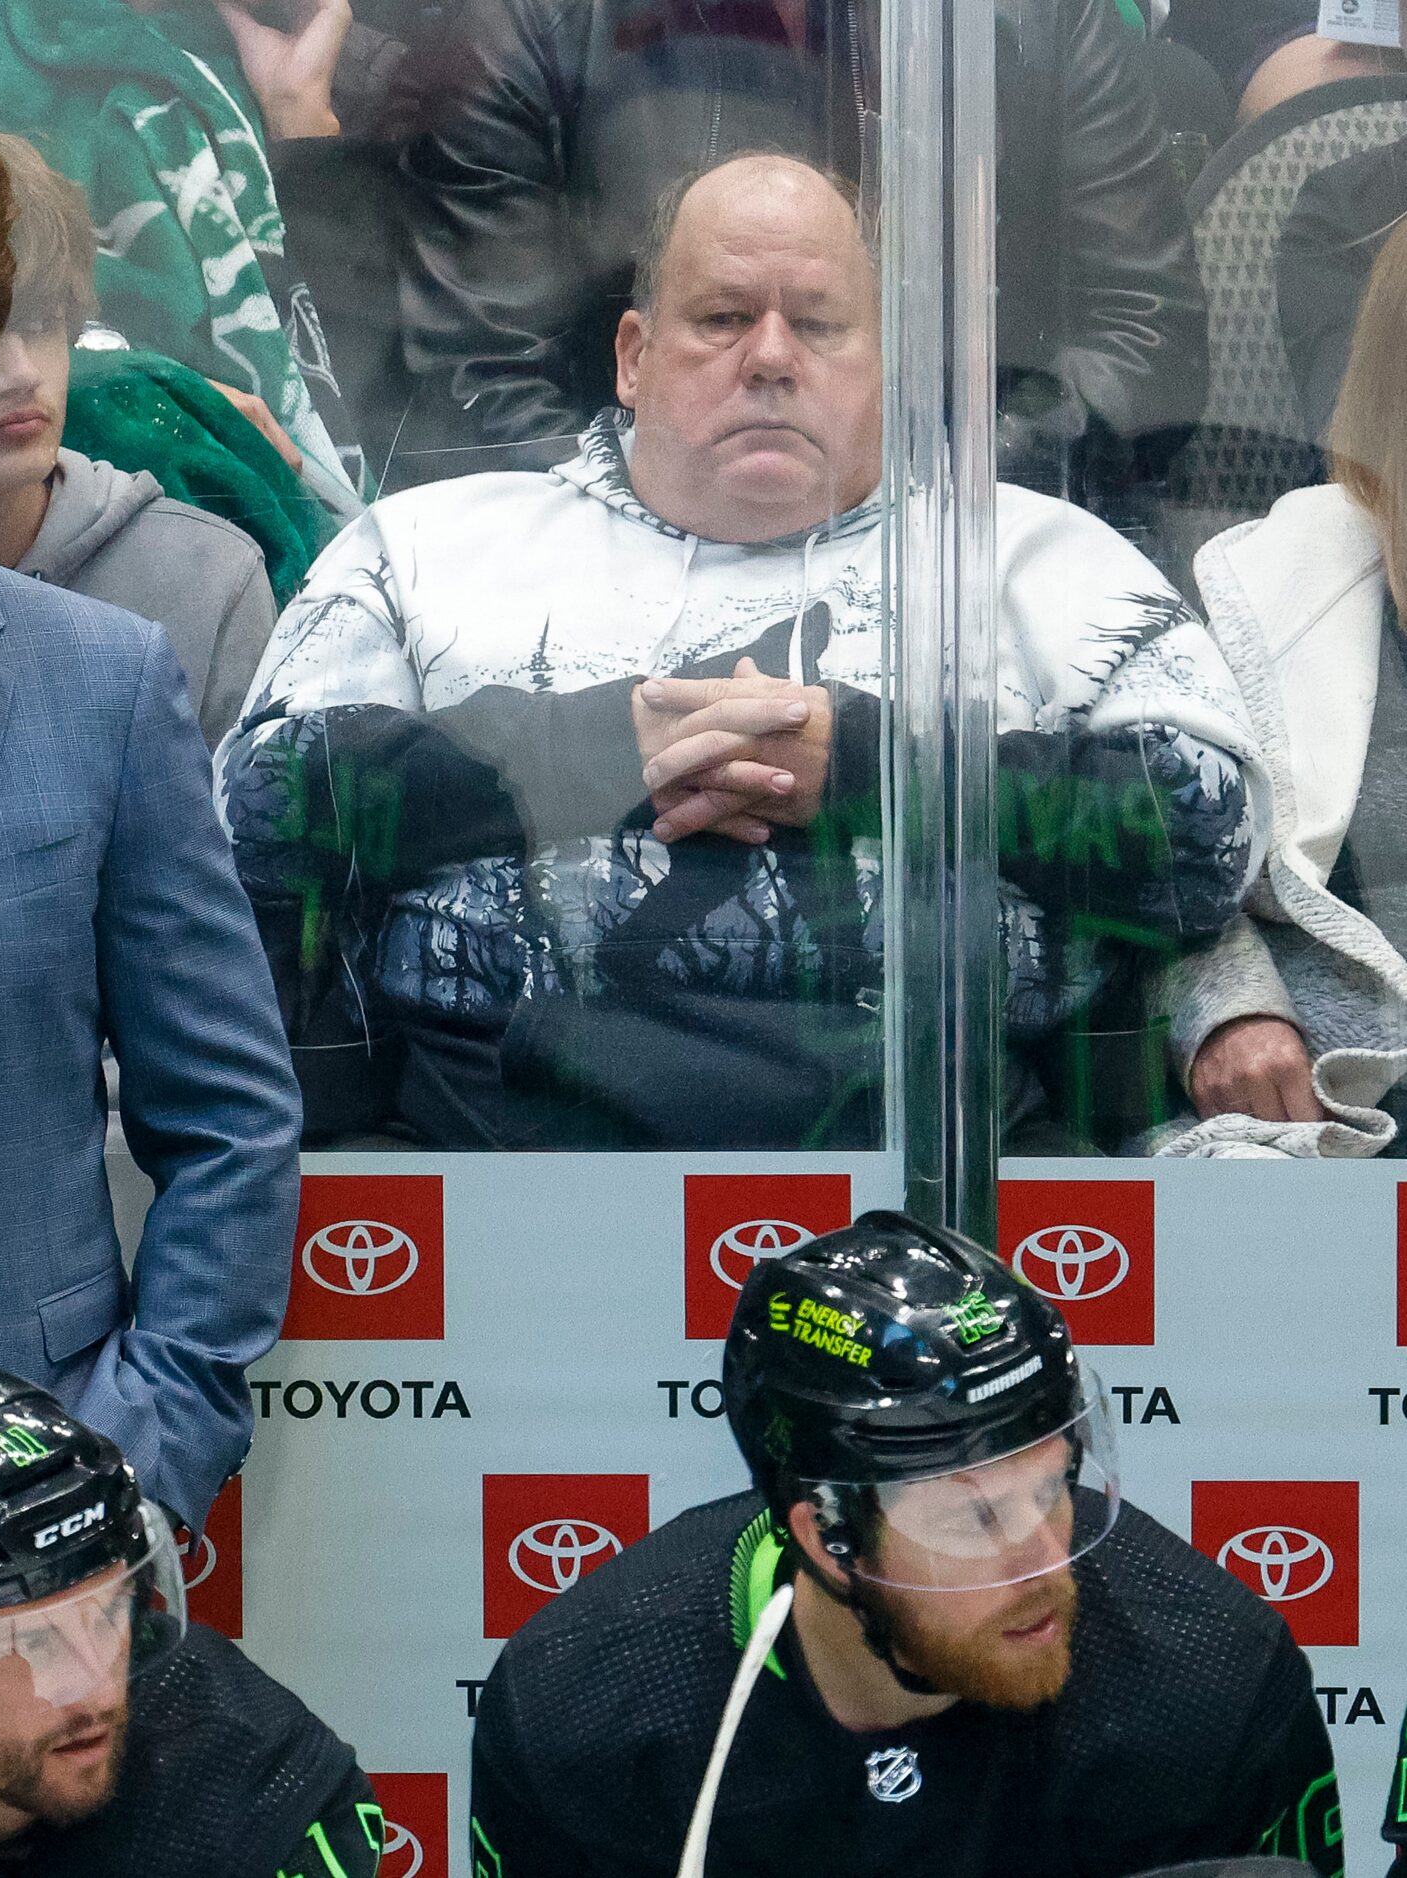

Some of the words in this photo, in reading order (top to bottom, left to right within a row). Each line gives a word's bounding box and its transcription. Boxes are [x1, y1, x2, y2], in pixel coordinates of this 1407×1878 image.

[797, 1298, 867, 1337] ENERGY
[792, 1318, 873, 1368] TRANSFER
[250, 1380, 471, 1419] TOYOTA
[966, 1354, 1044, 1404] WARRIOR
[33, 1501, 106, 1549] CCM
